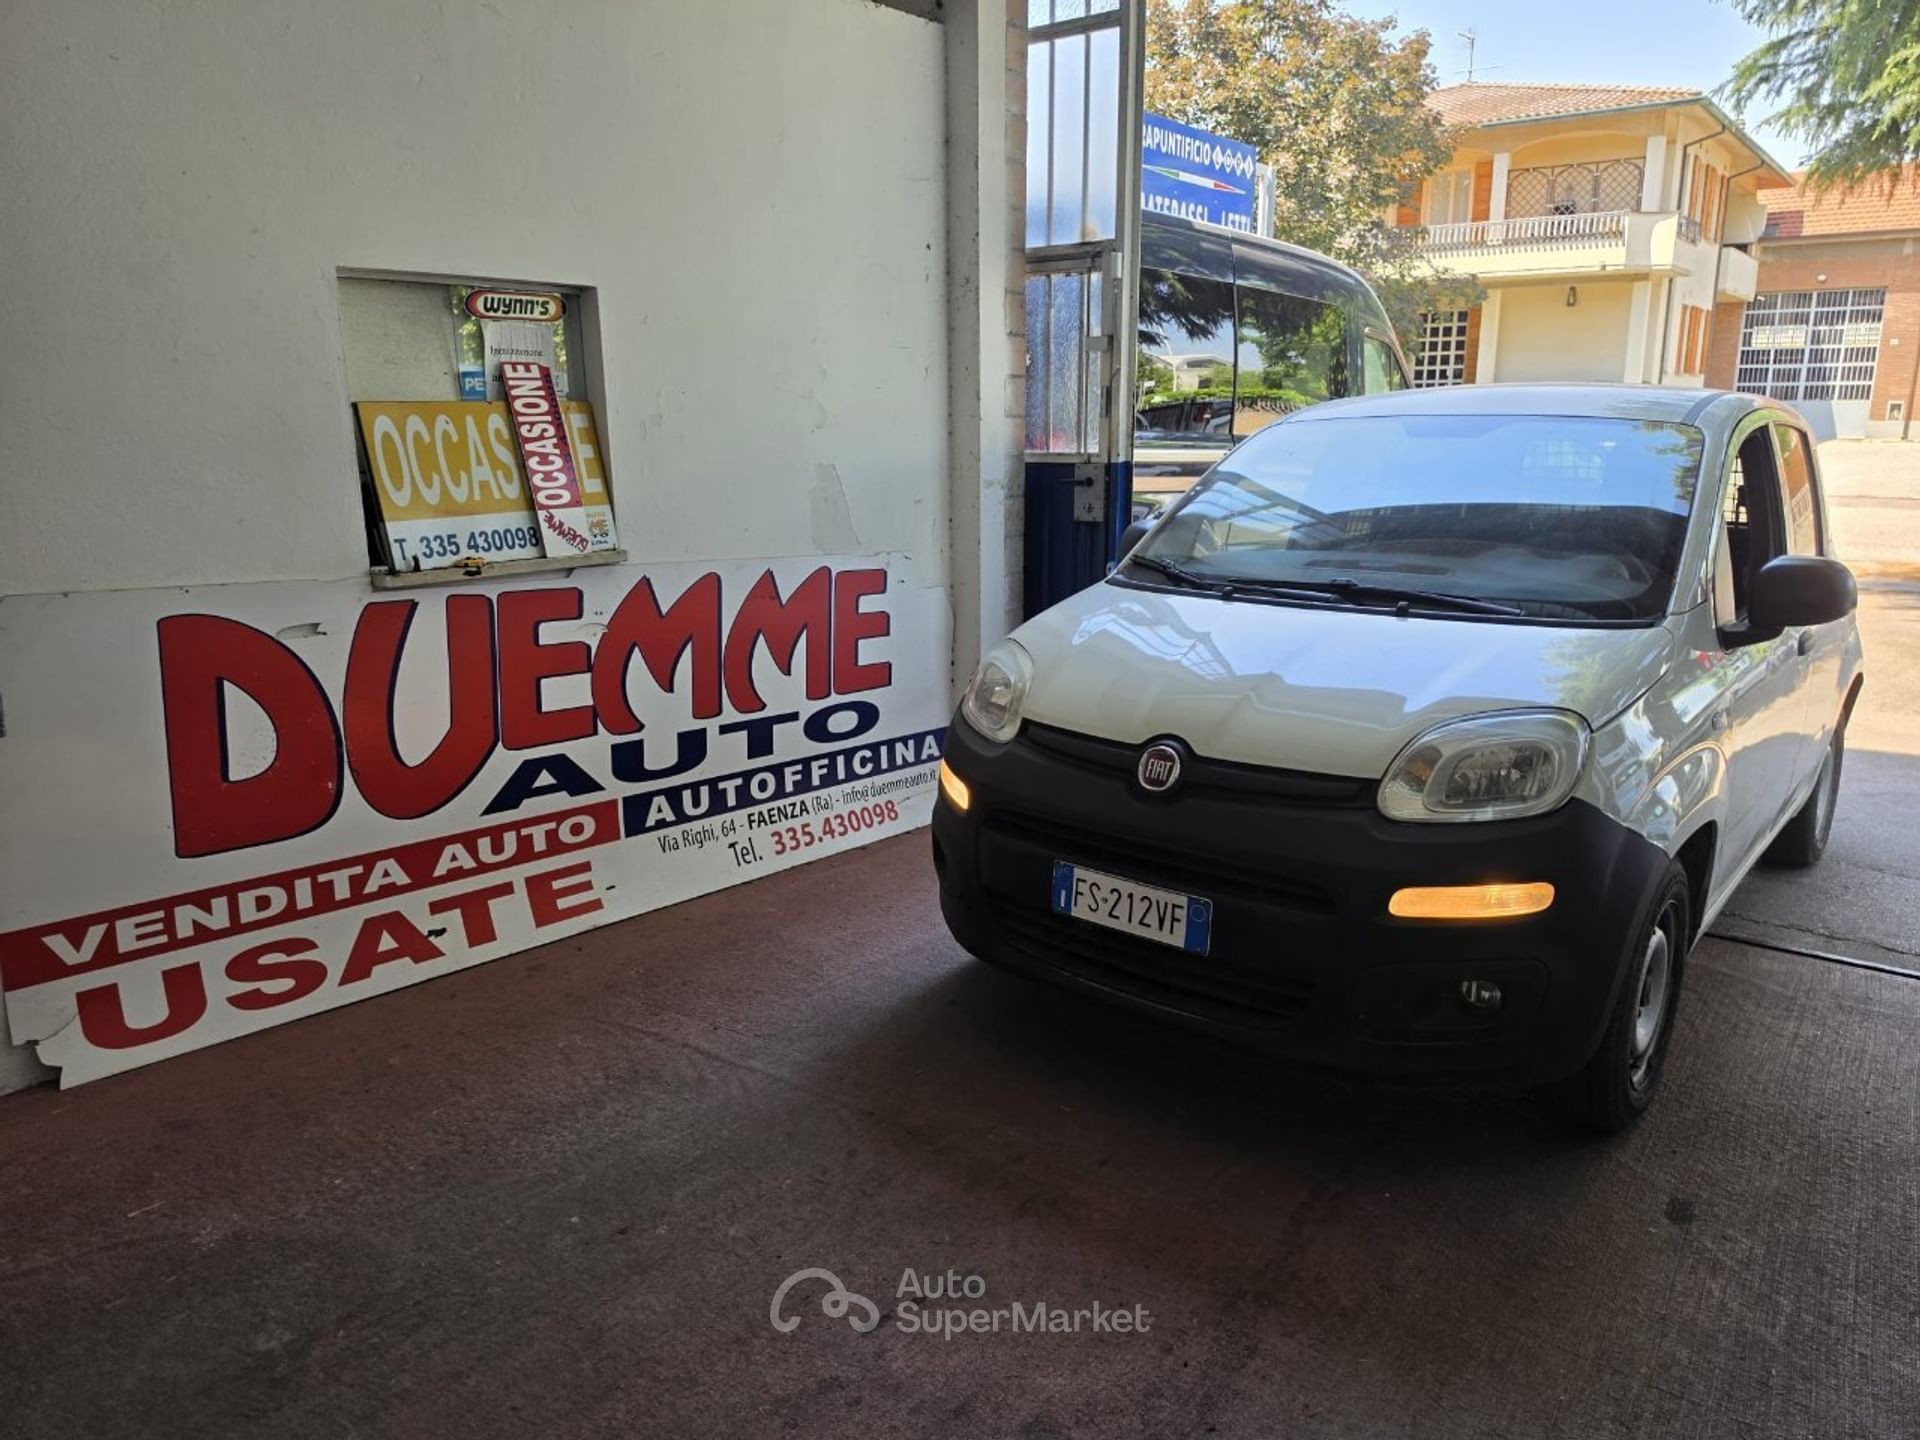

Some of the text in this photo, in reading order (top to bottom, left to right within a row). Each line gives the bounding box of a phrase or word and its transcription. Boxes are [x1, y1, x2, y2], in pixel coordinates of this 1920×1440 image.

[503, 362, 572, 506] OCCASIONE
[420, 534, 461, 559] 335
[466, 526, 540, 553] 430098
[157, 566, 893, 859] DUEMME
[479, 700, 880, 817] AUTO
[644, 734, 941, 828] AUTOFFICINA
[657, 836, 680, 854] Via
[682, 824, 719, 849] Righi,
[721, 819, 737, 838] 64
[746, 800, 811, 831] FAENZA
[811, 793, 835, 815] (Ra)
[841, 767, 937, 805] info@duemmeauto.it
[1145, 758, 1173, 781] FIAT
[728, 799, 899, 868] Tel. 335.430098
[41, 813, 597, 967] VENDITA AUTO
[75, 860, 606, 1050] USATE
